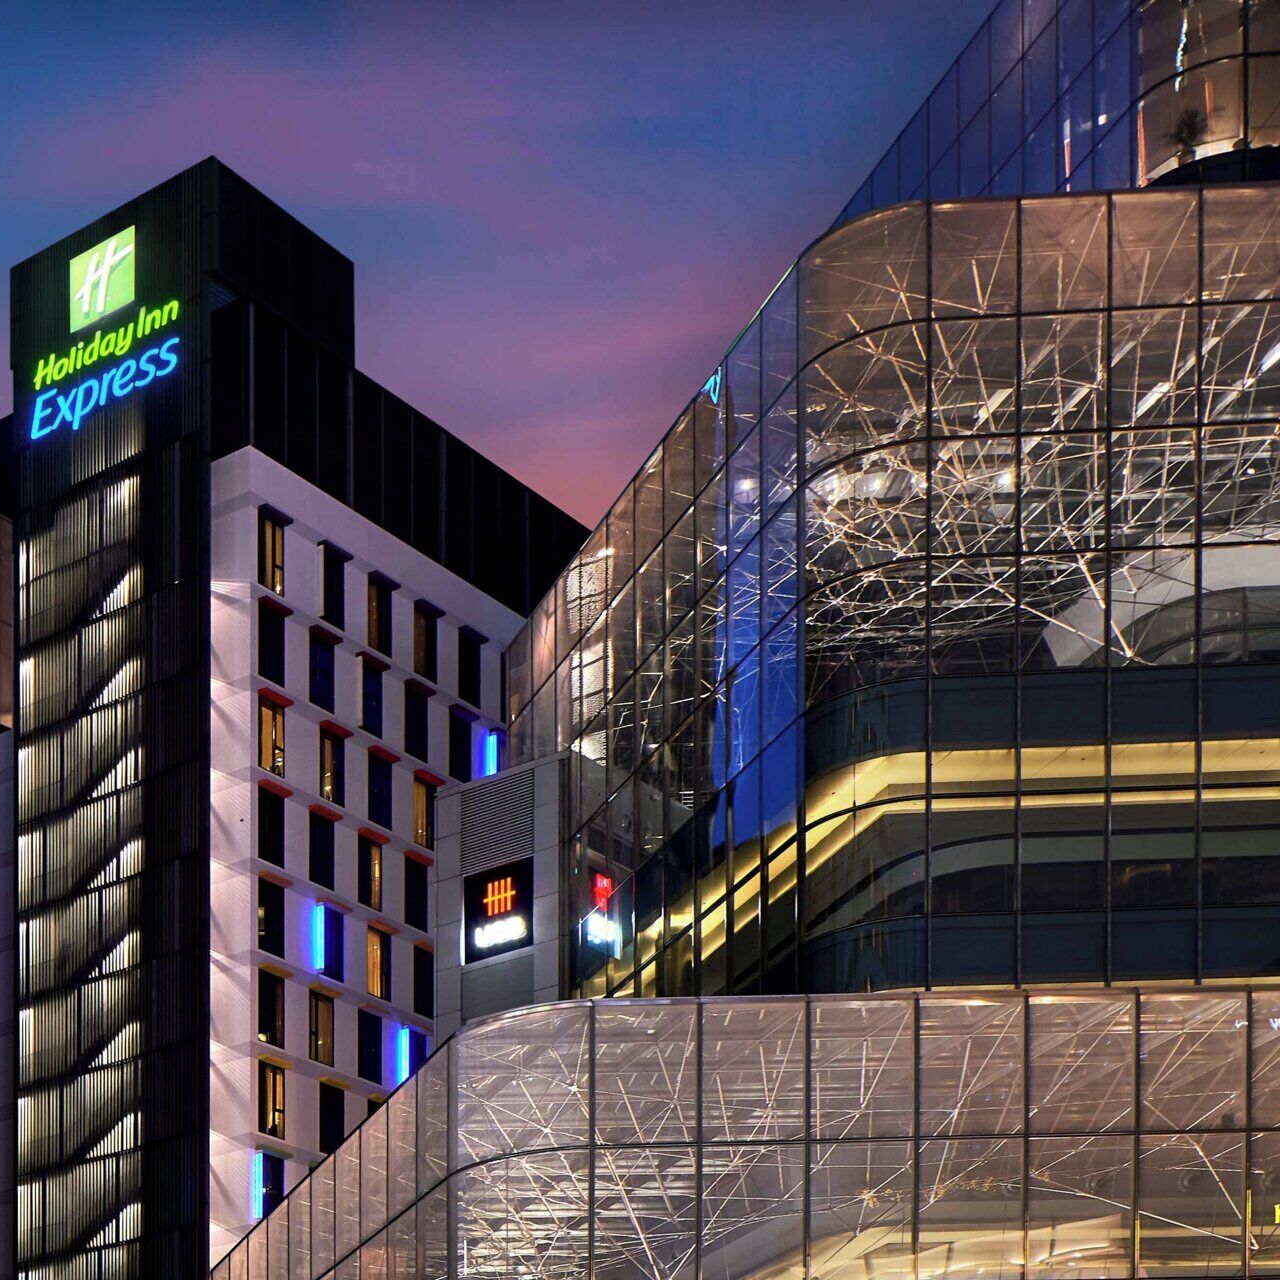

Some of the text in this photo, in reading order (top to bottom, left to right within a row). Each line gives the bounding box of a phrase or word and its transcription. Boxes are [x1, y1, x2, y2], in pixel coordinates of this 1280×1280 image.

[30, 337, 180, 440] Express
[33, 300, 179, 391] Holiday Inn
